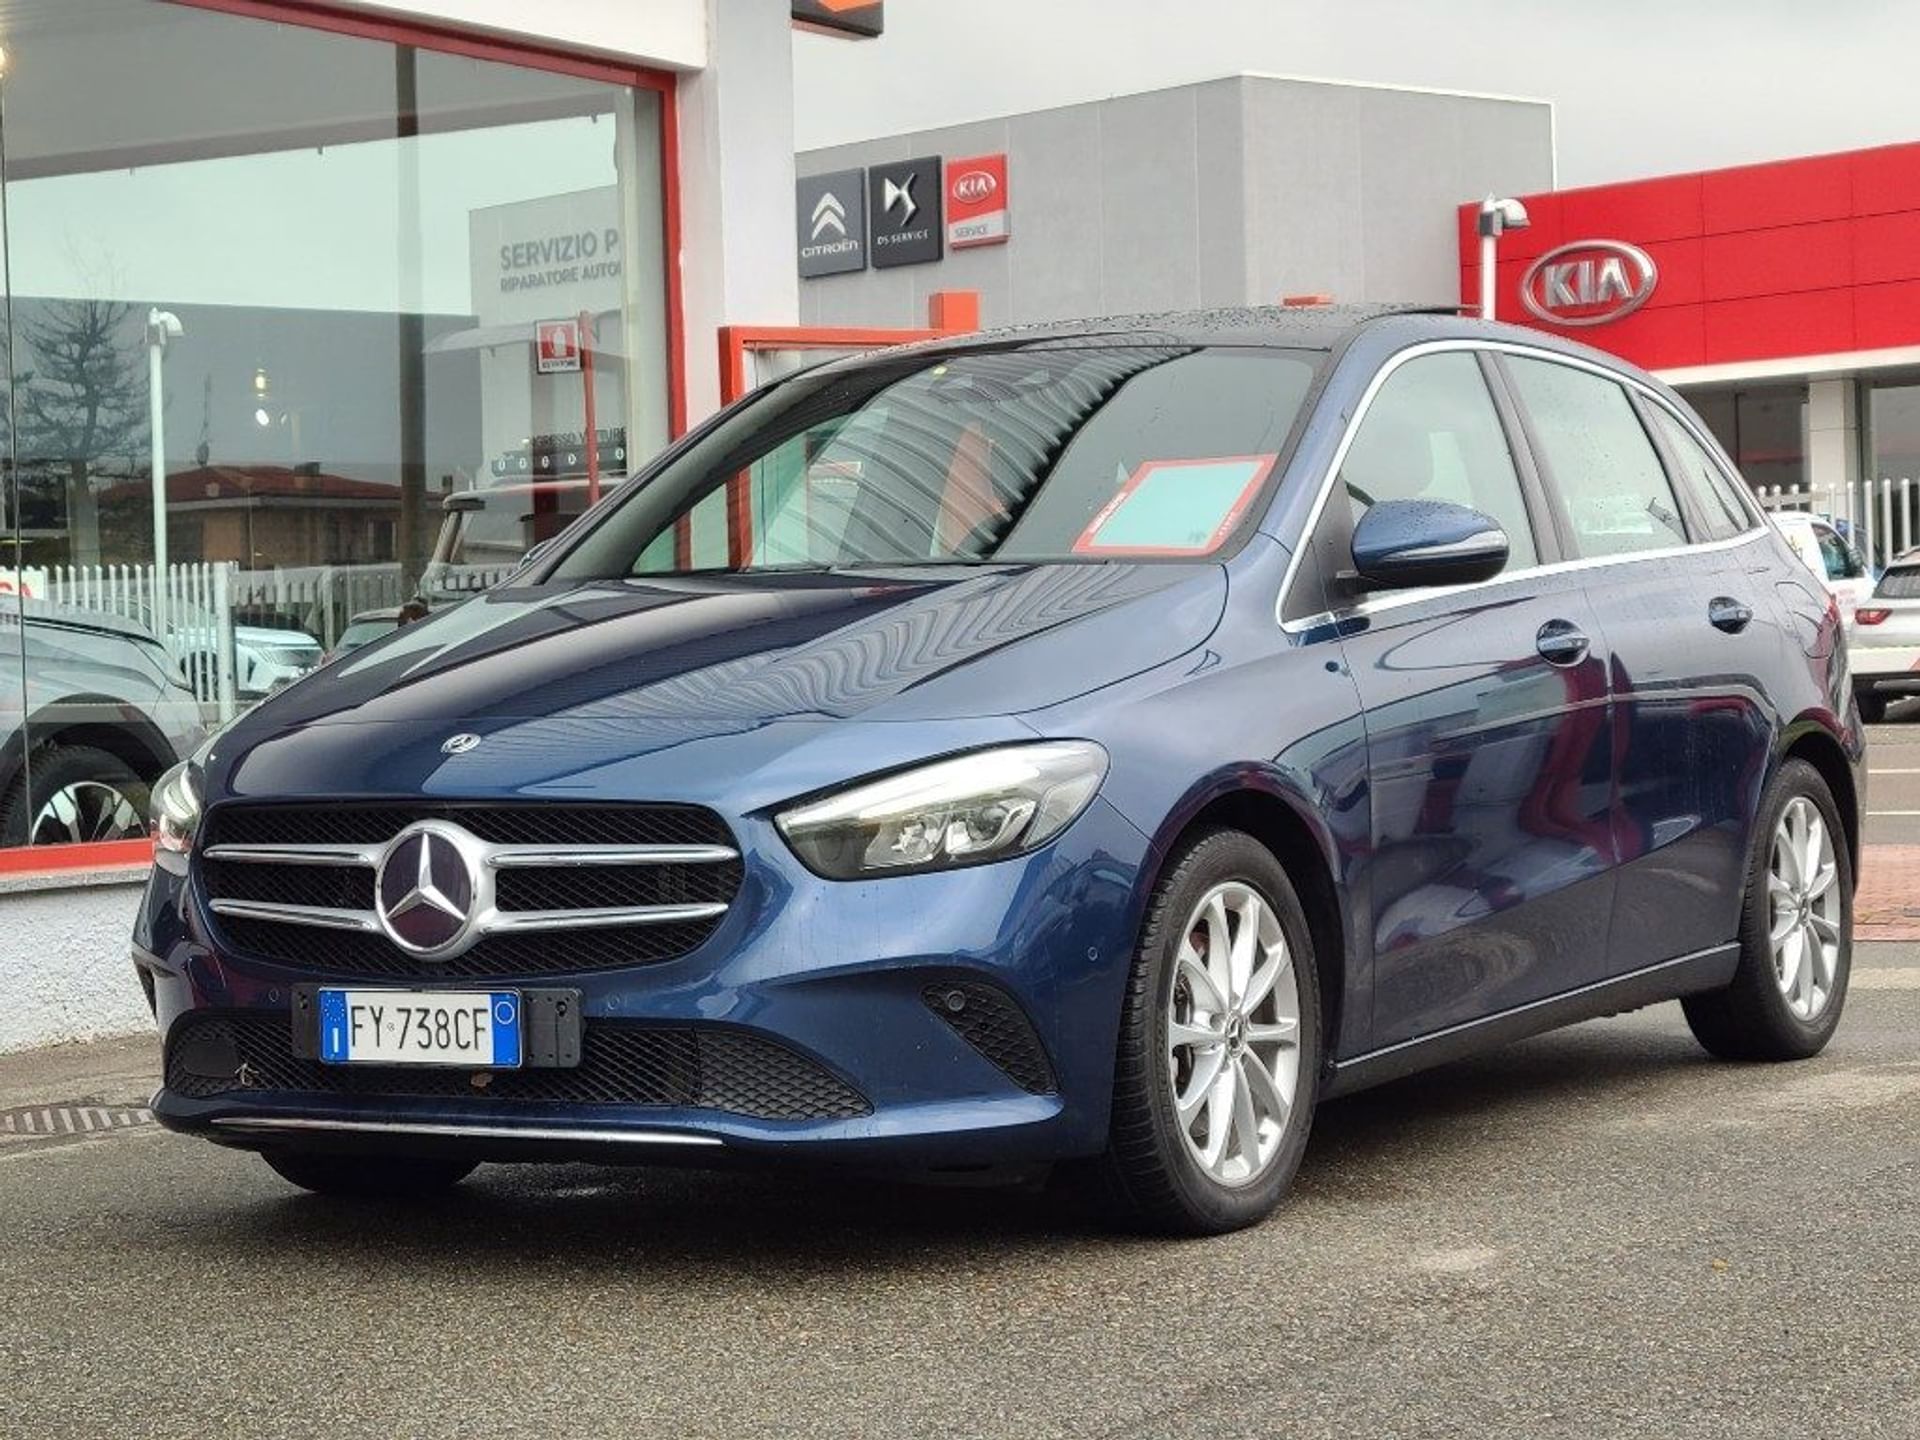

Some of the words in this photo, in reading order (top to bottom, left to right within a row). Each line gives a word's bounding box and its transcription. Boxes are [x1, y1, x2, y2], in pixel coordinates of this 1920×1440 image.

[958, 176, 989, 194] KIA
[801, 239, 859, 259] CITROËN
[890, 229, 929, 244] SERVICE
[500, 230, 598, 271] SERVIZIO
[500, 266, 579, 293] RIPARATORE
[1544, 256, 1635, 307] KIA
[351, 1005, 384, 1048] FY
[396, 1007, 489, 1051] 738CF
